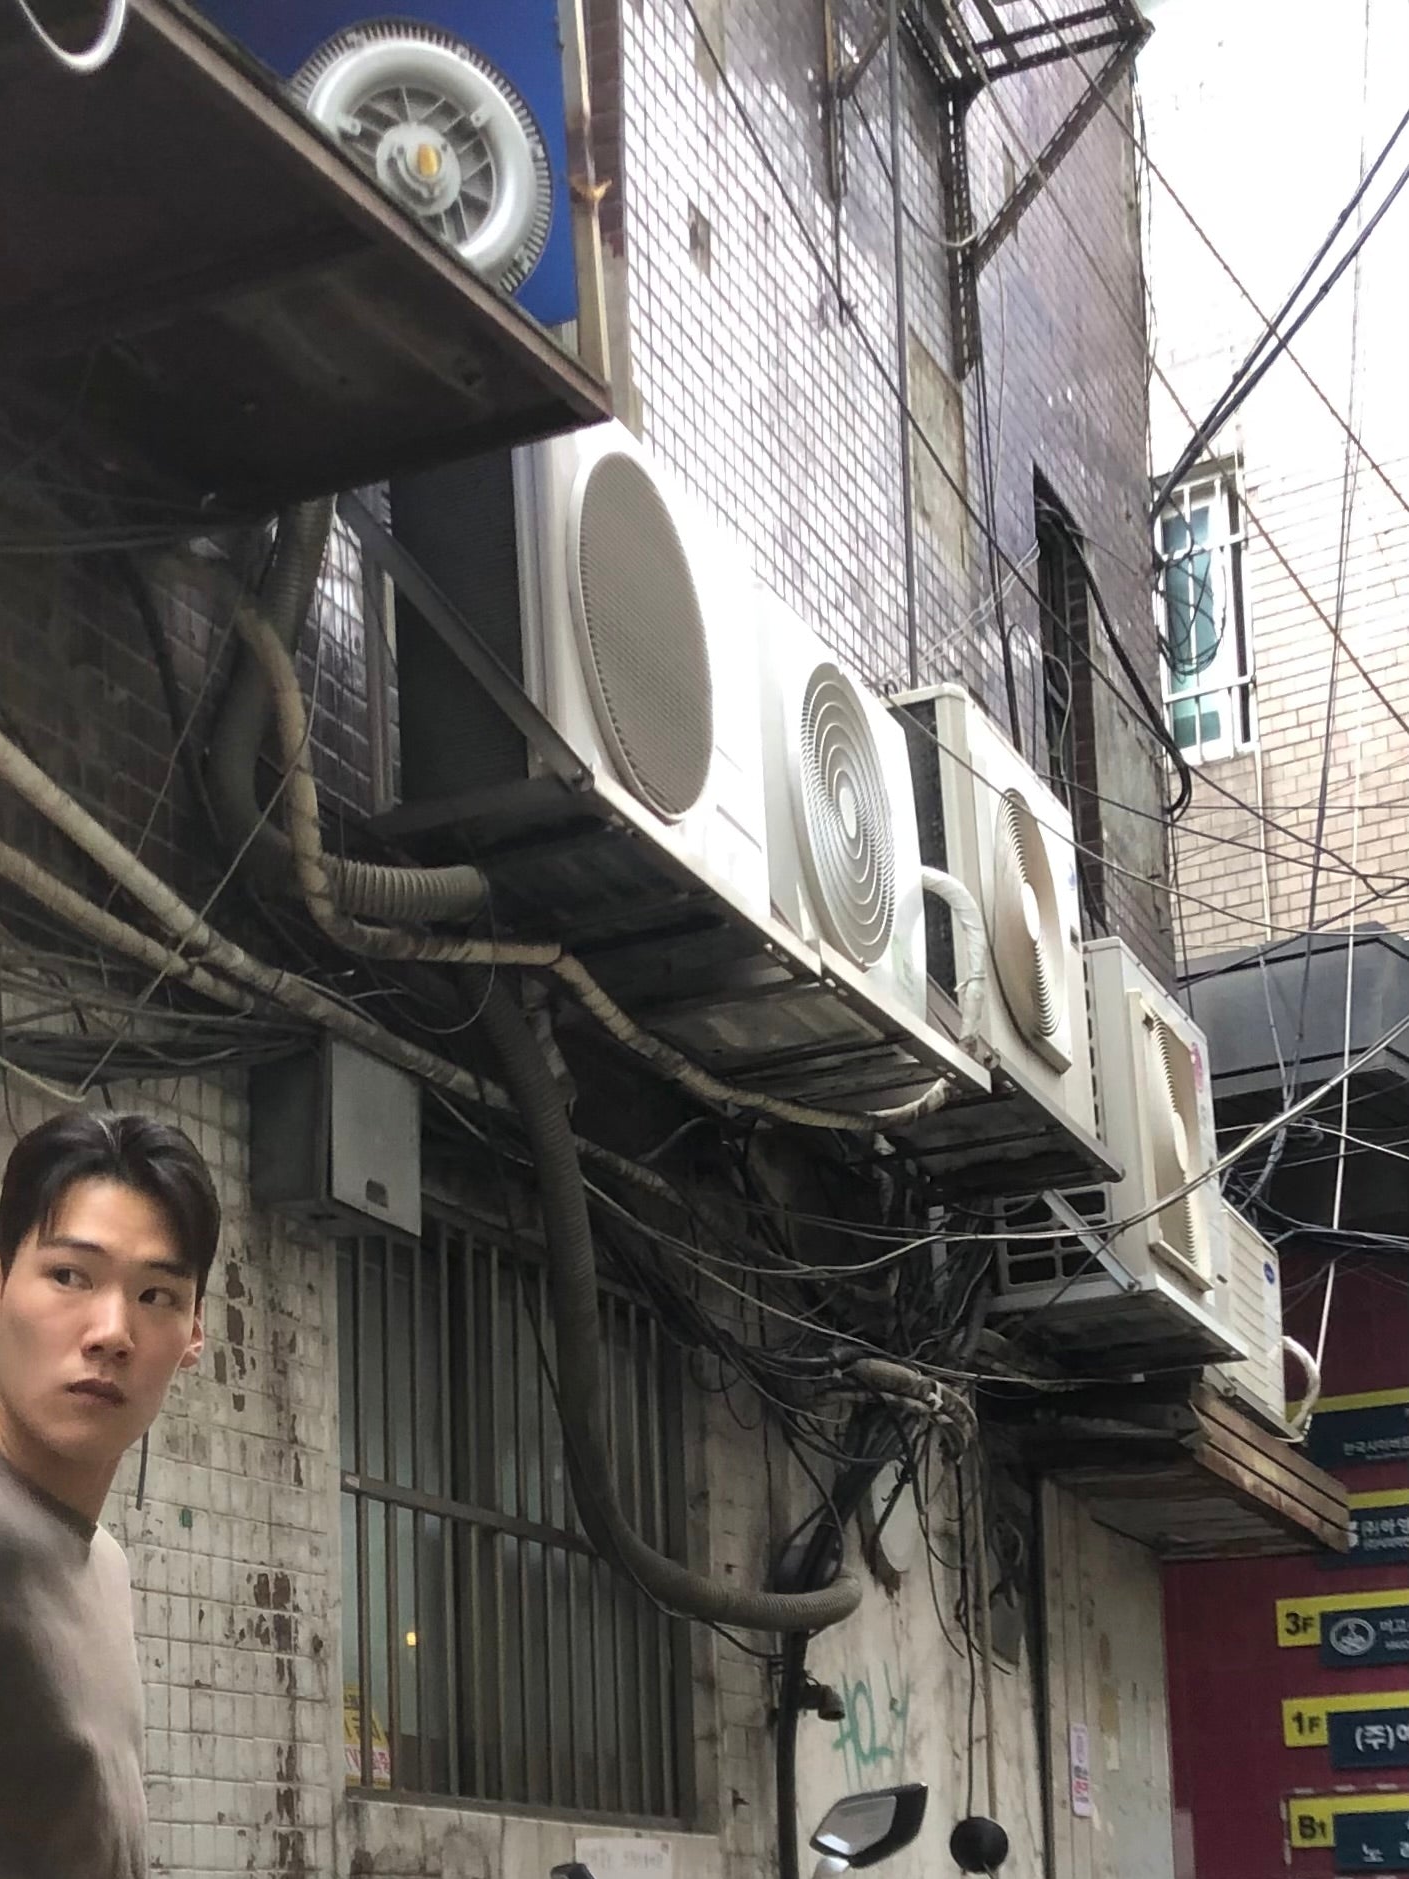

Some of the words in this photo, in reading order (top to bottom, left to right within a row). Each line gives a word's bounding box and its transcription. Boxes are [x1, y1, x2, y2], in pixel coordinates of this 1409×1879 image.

[1285, 1612, 1315, 1636] 3F
[1292, 1710, 1321, 1736] 1F
[1297, 1814, 1327, 1839] B1
